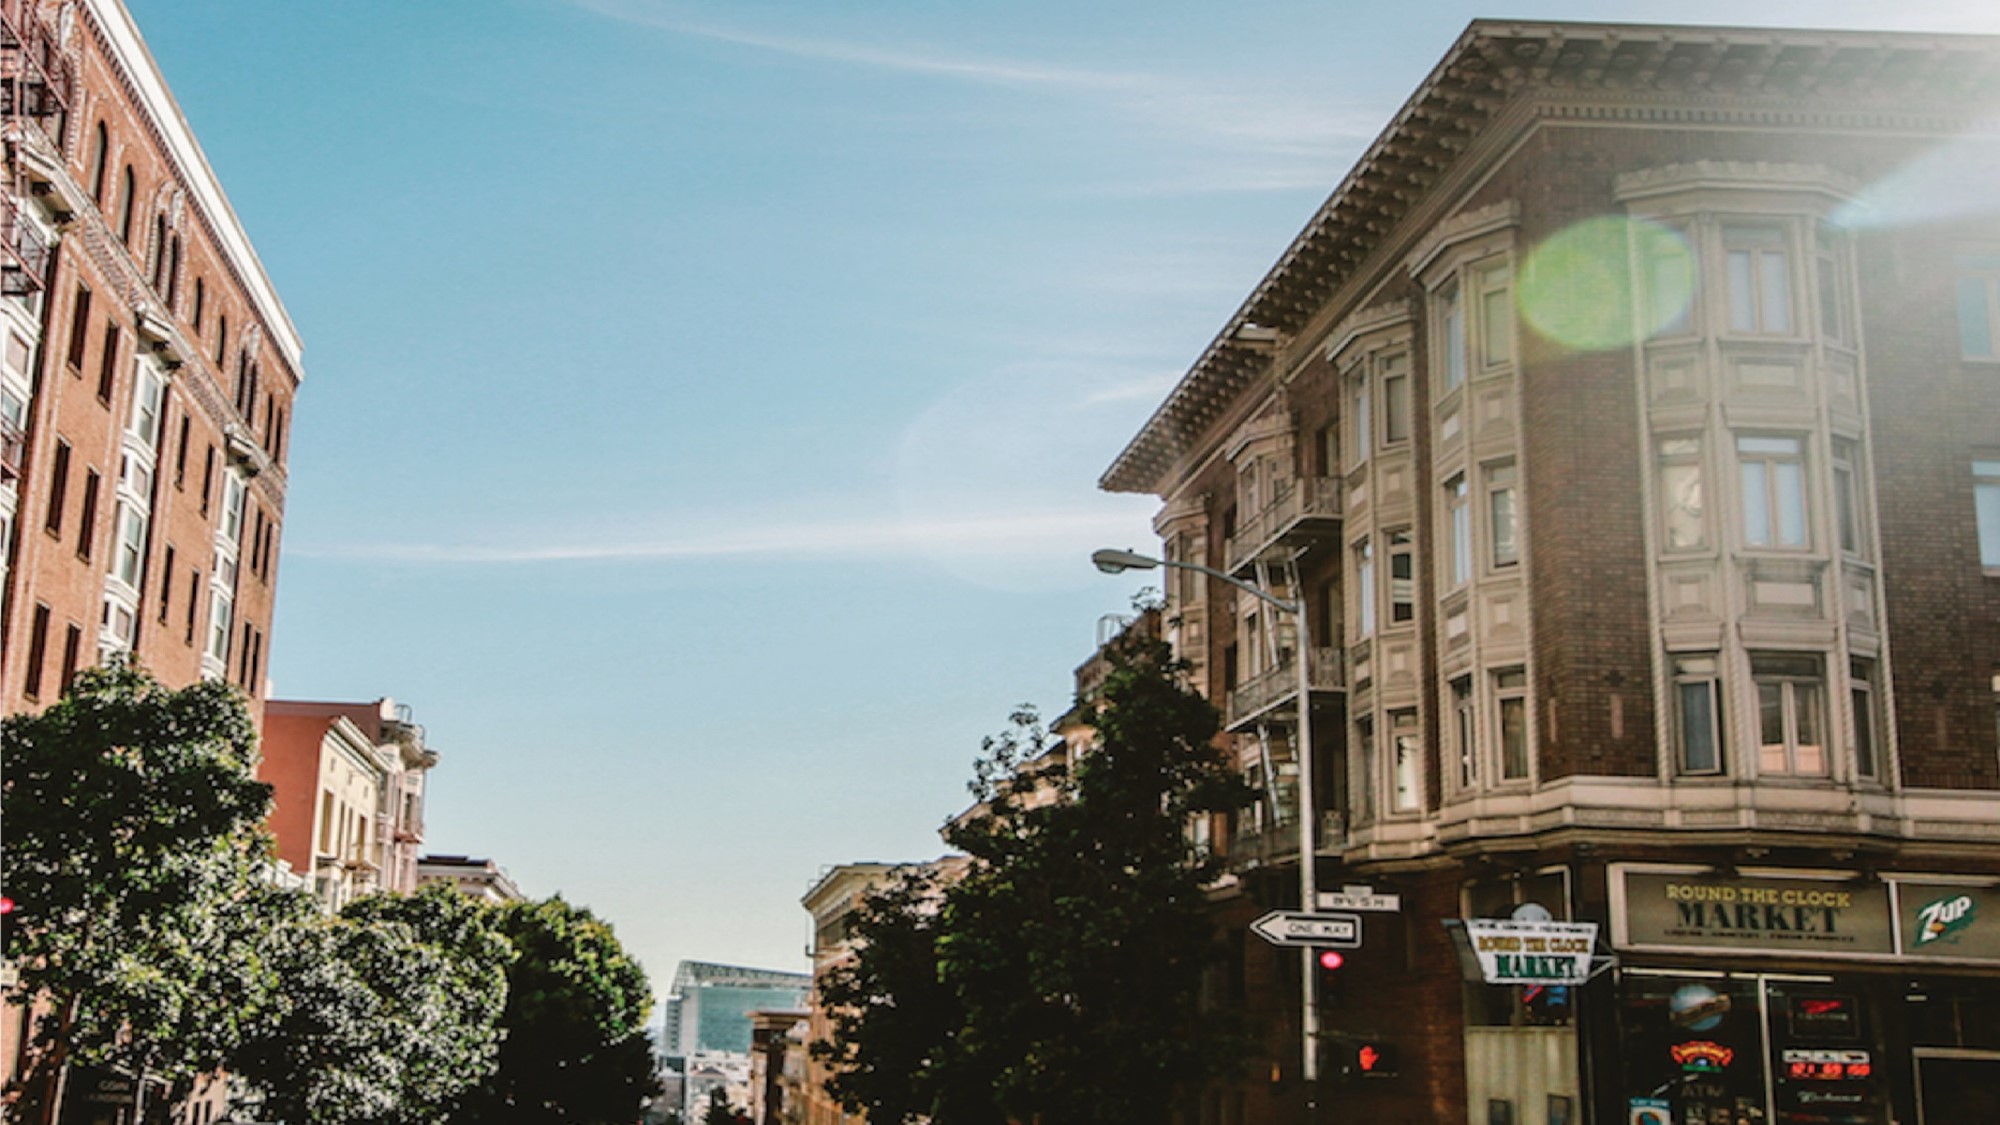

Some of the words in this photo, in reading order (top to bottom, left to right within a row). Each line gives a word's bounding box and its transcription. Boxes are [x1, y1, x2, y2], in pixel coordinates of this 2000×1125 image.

[1666, 884, 1737, 905] ROUND
[1739, 888, 1779, 904] THE
[1781, 889, 1851, 908] CLOCK
[1288, 923, 1313, 934] ONE
[1322, 925, 1350, 935] WAY
[1676, 902, 1842, 933] MARKET
[1523, 937, 1547, 952] THE
[1550, 938, 1589, 953] CLOCK
[1495, 954, 1576, 978] MARKET
